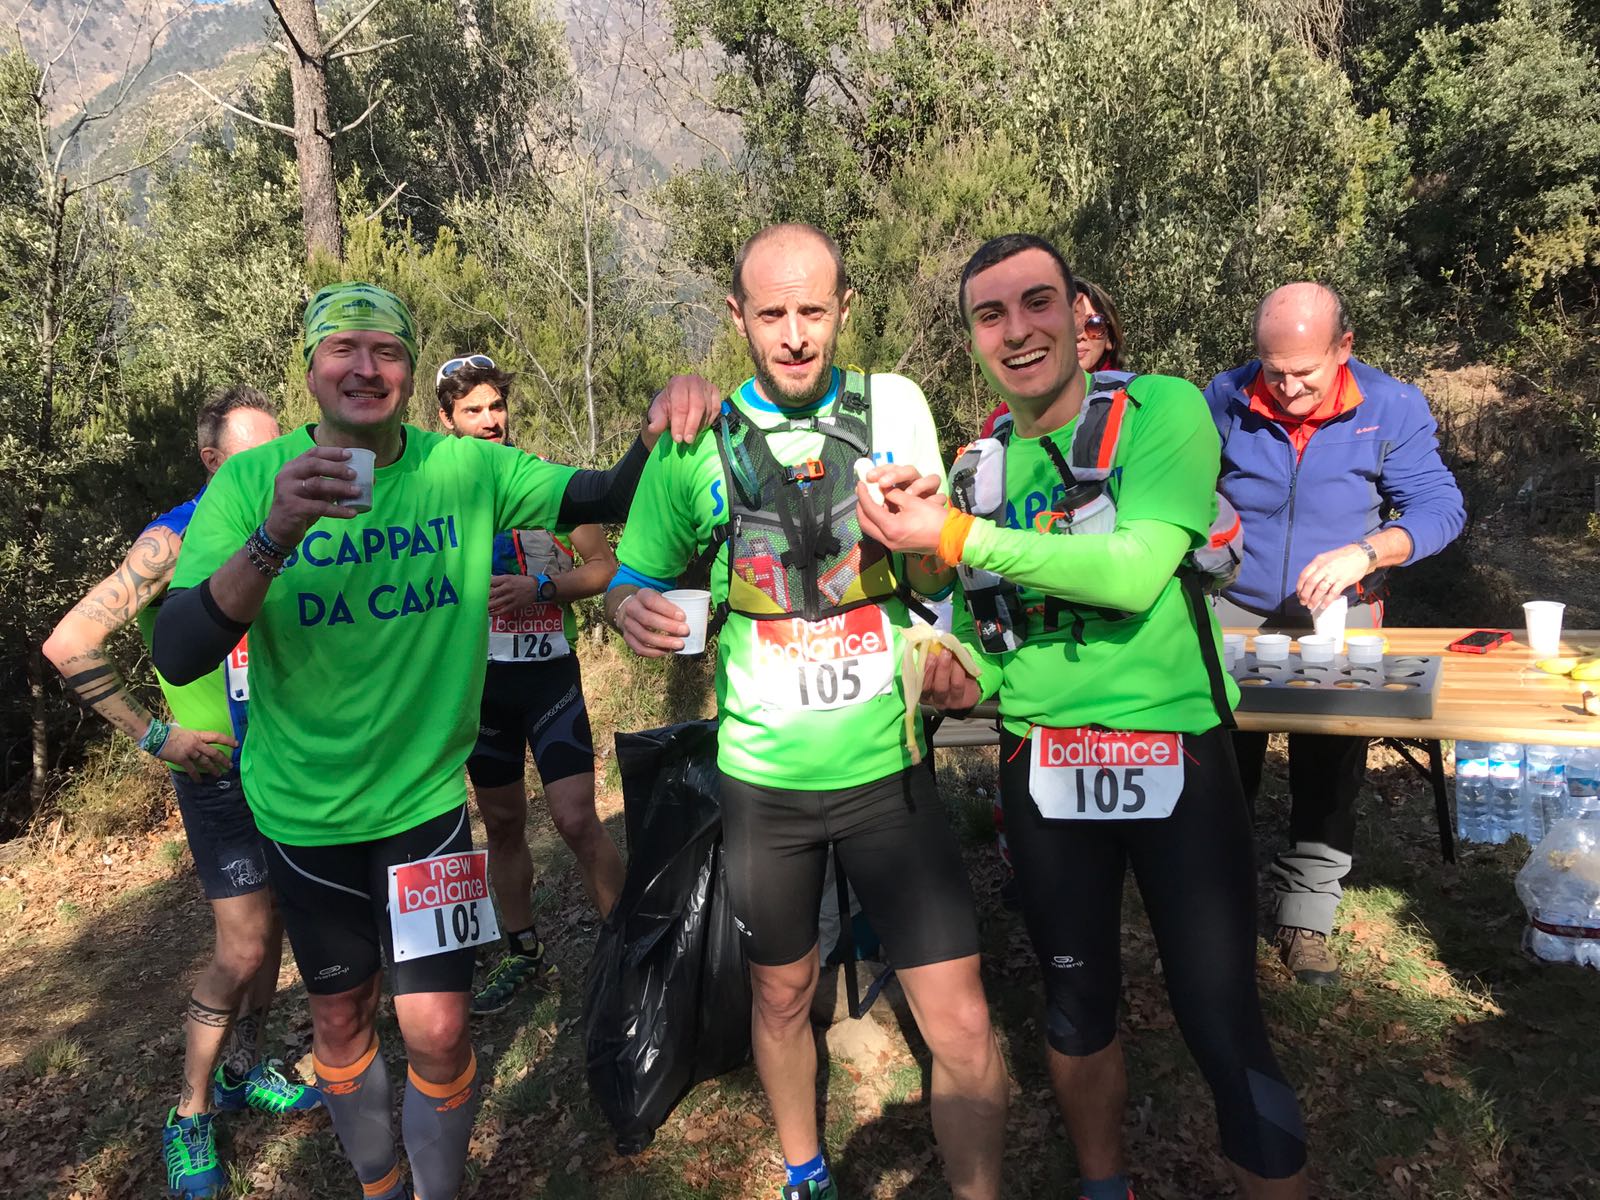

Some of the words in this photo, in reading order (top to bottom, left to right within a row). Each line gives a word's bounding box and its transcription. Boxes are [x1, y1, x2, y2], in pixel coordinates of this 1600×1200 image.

[298, 591, 355, 627] DA
[367, 574, 459, 620] CASA
[496, 615, 561, 632] balance
[513, 633, 552, 658] 126
[764, 631, 880, 661] balance
[798, 659, 861, 706] 105
[1048, 738, 1170, 765] balance
[1075, 768, 1146, 813] 105
[429, 857, 471, 880] new
[404, 878, 483, 910] balance
[434, 901, 480, 948] 105
